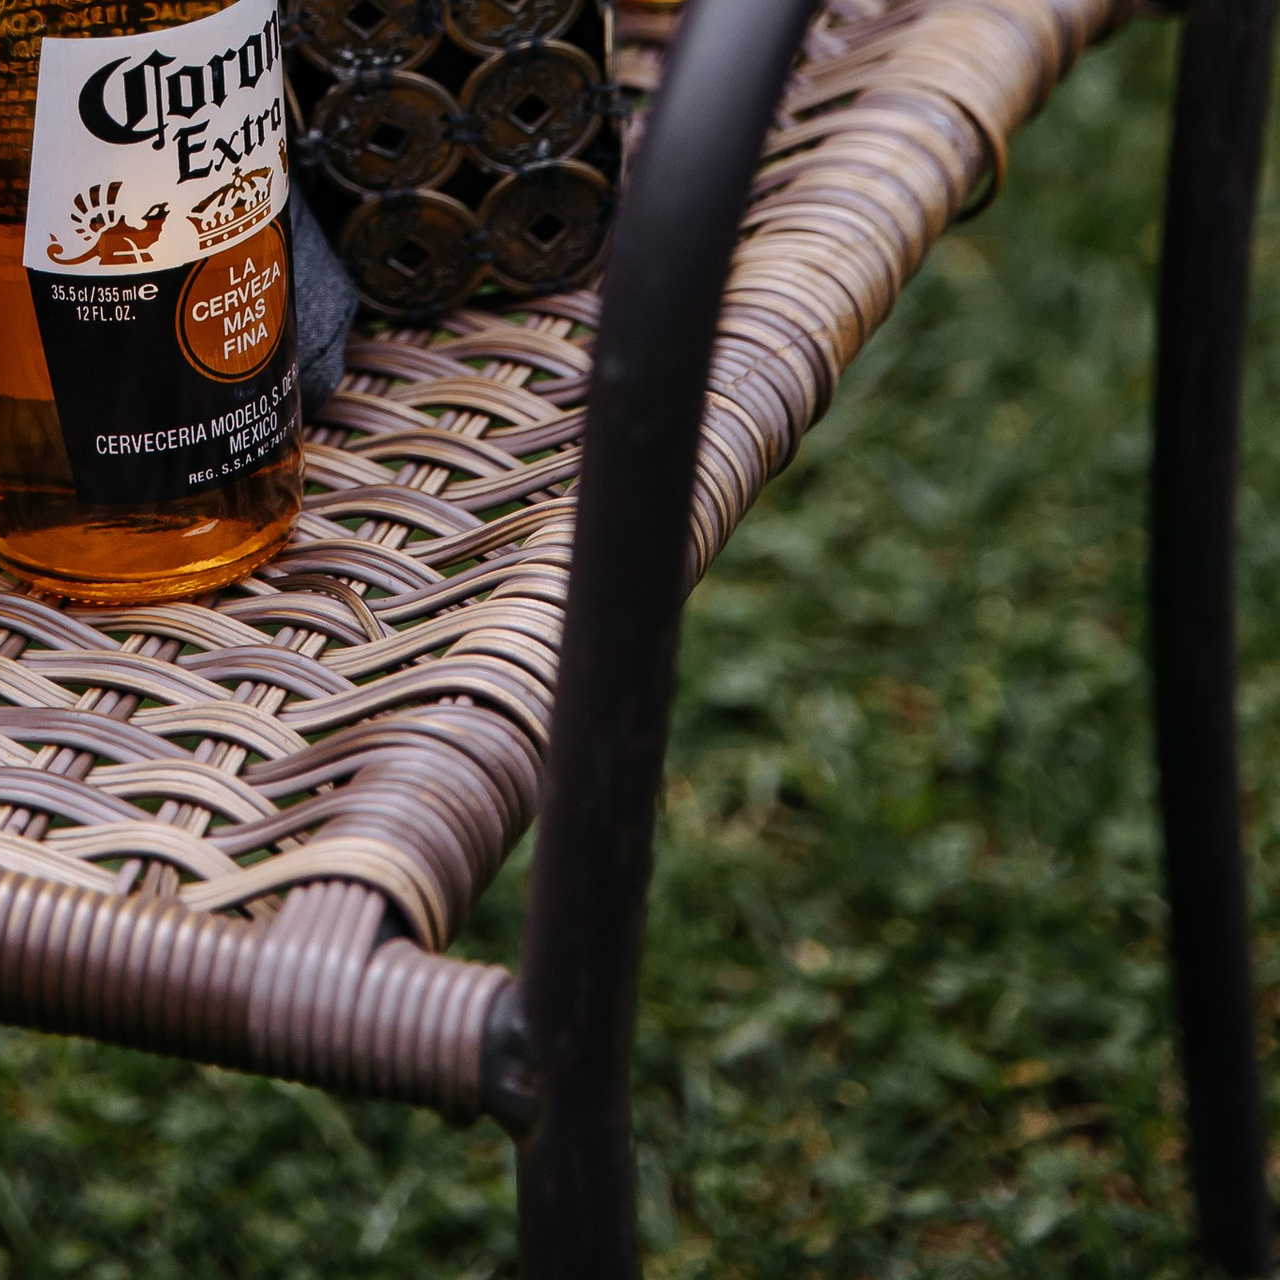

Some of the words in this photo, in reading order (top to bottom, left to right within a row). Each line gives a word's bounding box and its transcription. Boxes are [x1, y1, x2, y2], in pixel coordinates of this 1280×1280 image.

[78, 9, 282, 151] Coron
[172, 97, 282, 185] Extra
[228, 255, 257, 287] LA
[51, 284, 76, 302] 35.5
[77, 286, 89, 303] cl
[97, 286, 121, 304] 355
[122, 285, 137, 302] ml
[191, 261, 282, 323] CERVEZA
[76, 305, 91, 322] 12
[222, 297, 267, 337] MAS
[222, 321, 269, 361] FINA
[96, 422, 208, 455] CERVECERIA
[210, 393, 272, 439] MODELO,
[272, 386, 283, 407] S.
[282, 369, 293, 397] DE
[228, 411, 279, 455] MEXICO
[188, 468, 219, 485] REG.
